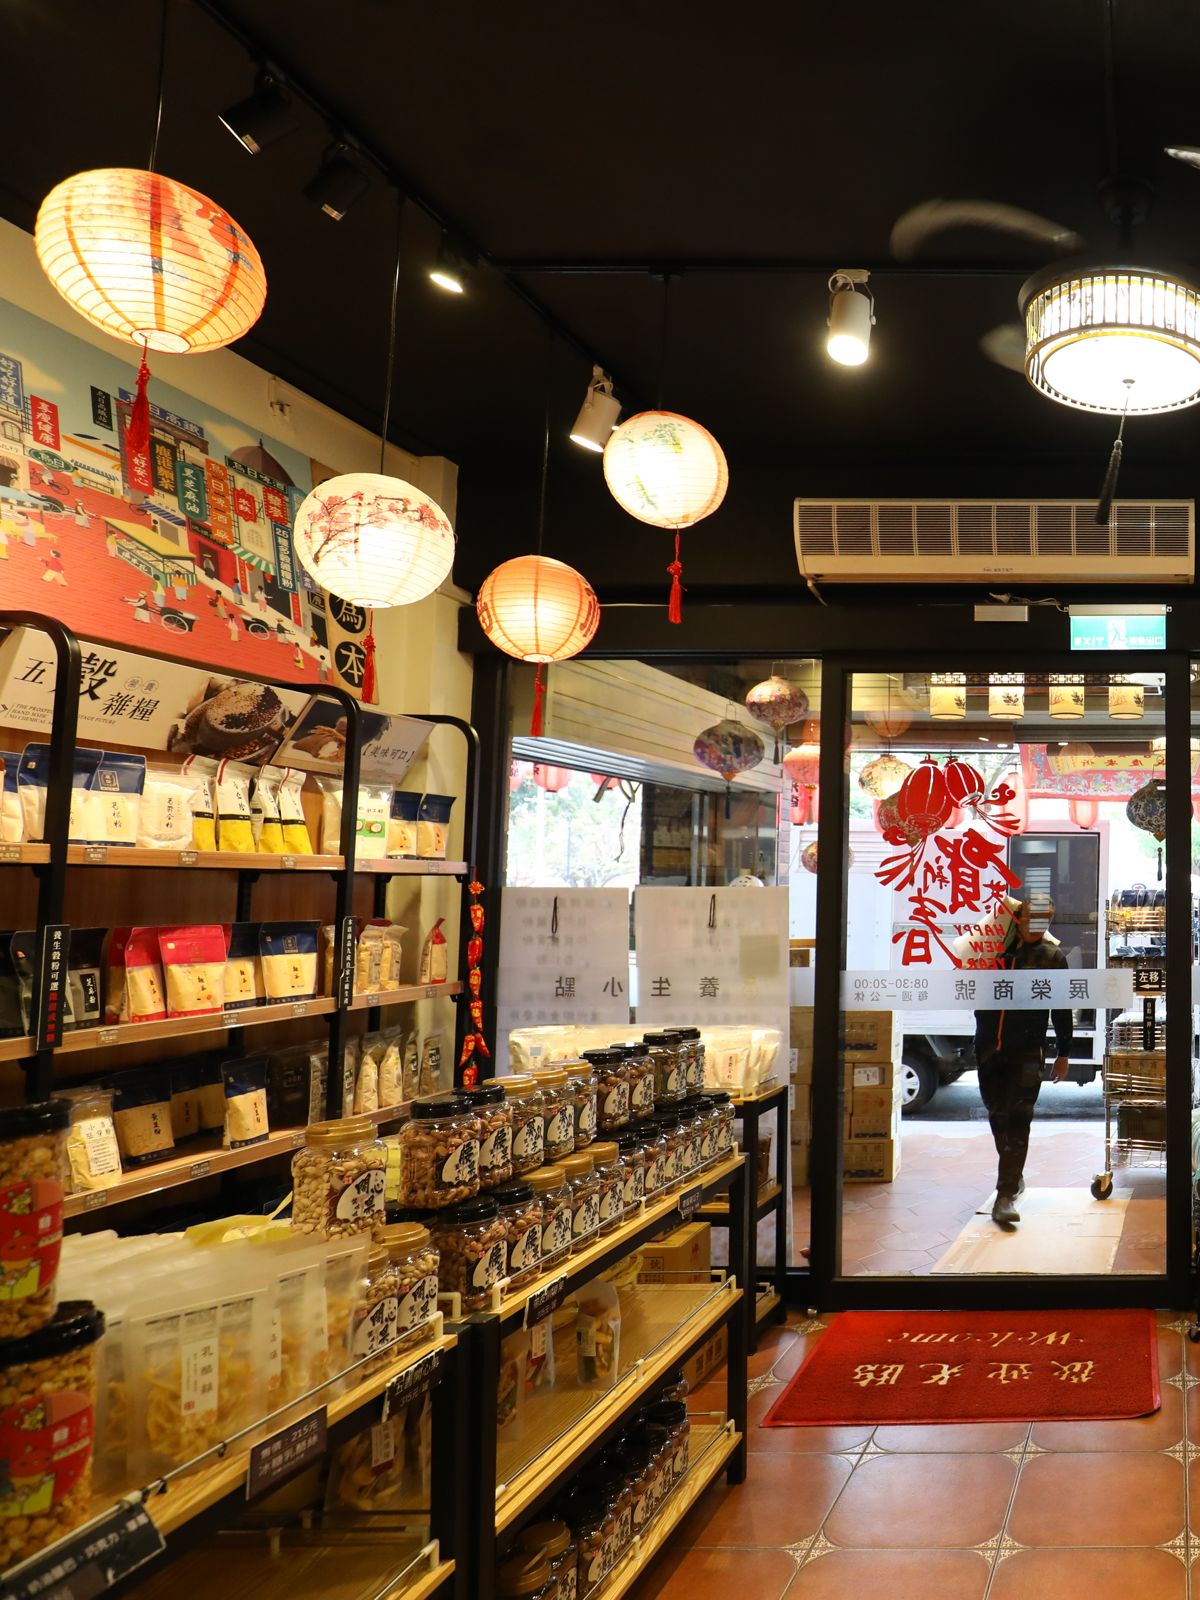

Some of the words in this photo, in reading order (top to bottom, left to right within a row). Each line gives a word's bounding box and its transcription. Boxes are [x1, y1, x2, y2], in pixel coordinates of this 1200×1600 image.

[1073, 636, 1105, 647] EXIT
[1138, 971, 1160, 983] 左移
[852, 1360, 1095, 1386] 歡迎光臨
